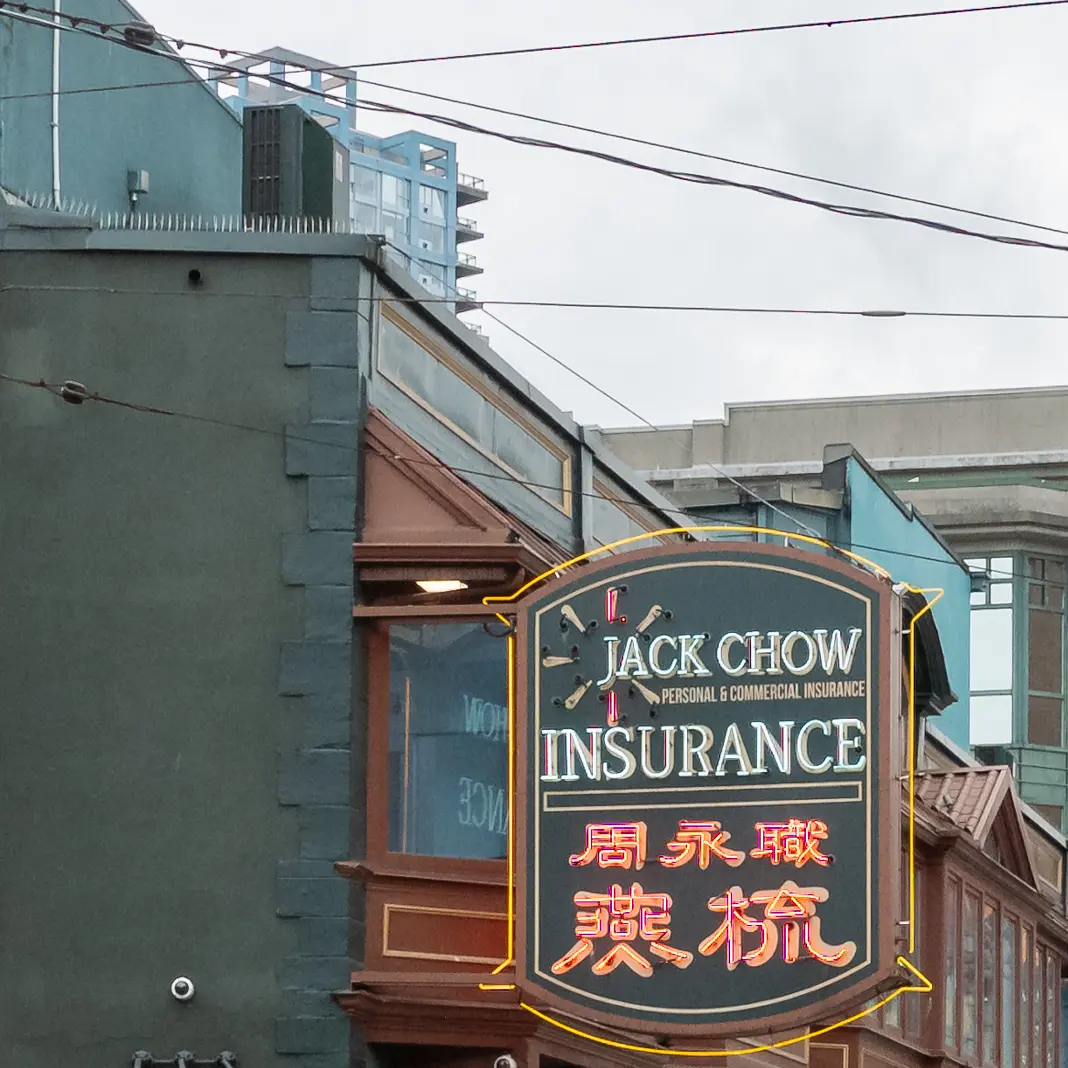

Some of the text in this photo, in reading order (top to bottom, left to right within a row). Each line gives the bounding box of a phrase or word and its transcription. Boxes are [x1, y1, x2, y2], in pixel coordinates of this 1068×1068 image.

[597, 629, 862, 690] JACK CHOW
[662, 680, 866, 704] PERSONAL & COMMERCIAL INSURANCE
[540, 718, 866, 782] INSURANCE
[568, 818, 829, 871] 周永職
